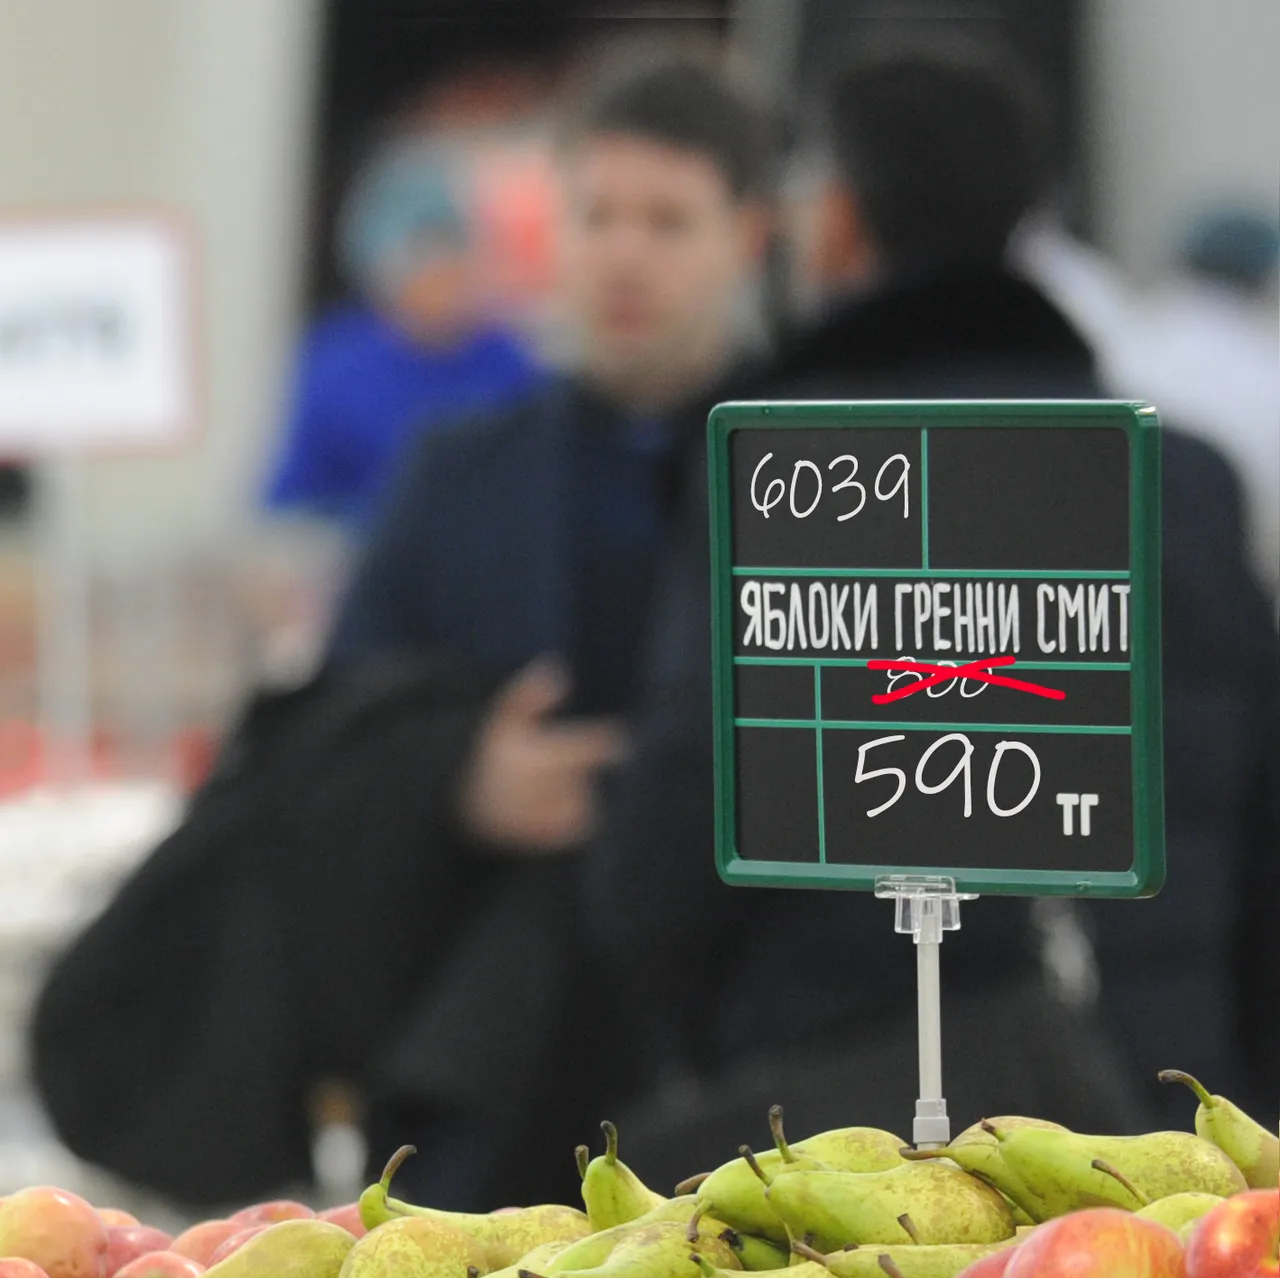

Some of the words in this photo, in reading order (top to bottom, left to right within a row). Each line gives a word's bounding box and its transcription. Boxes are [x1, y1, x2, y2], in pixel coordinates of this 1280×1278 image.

[750, 453, 910, 521] 6039
[740, 581, 878, 650] ЯБЛОКИ
[895, 582, 1020, 654] ГРЕННИ
[1037, 584, 1131, 653] СМИТ
[854, 733, 1041, 818] 590
